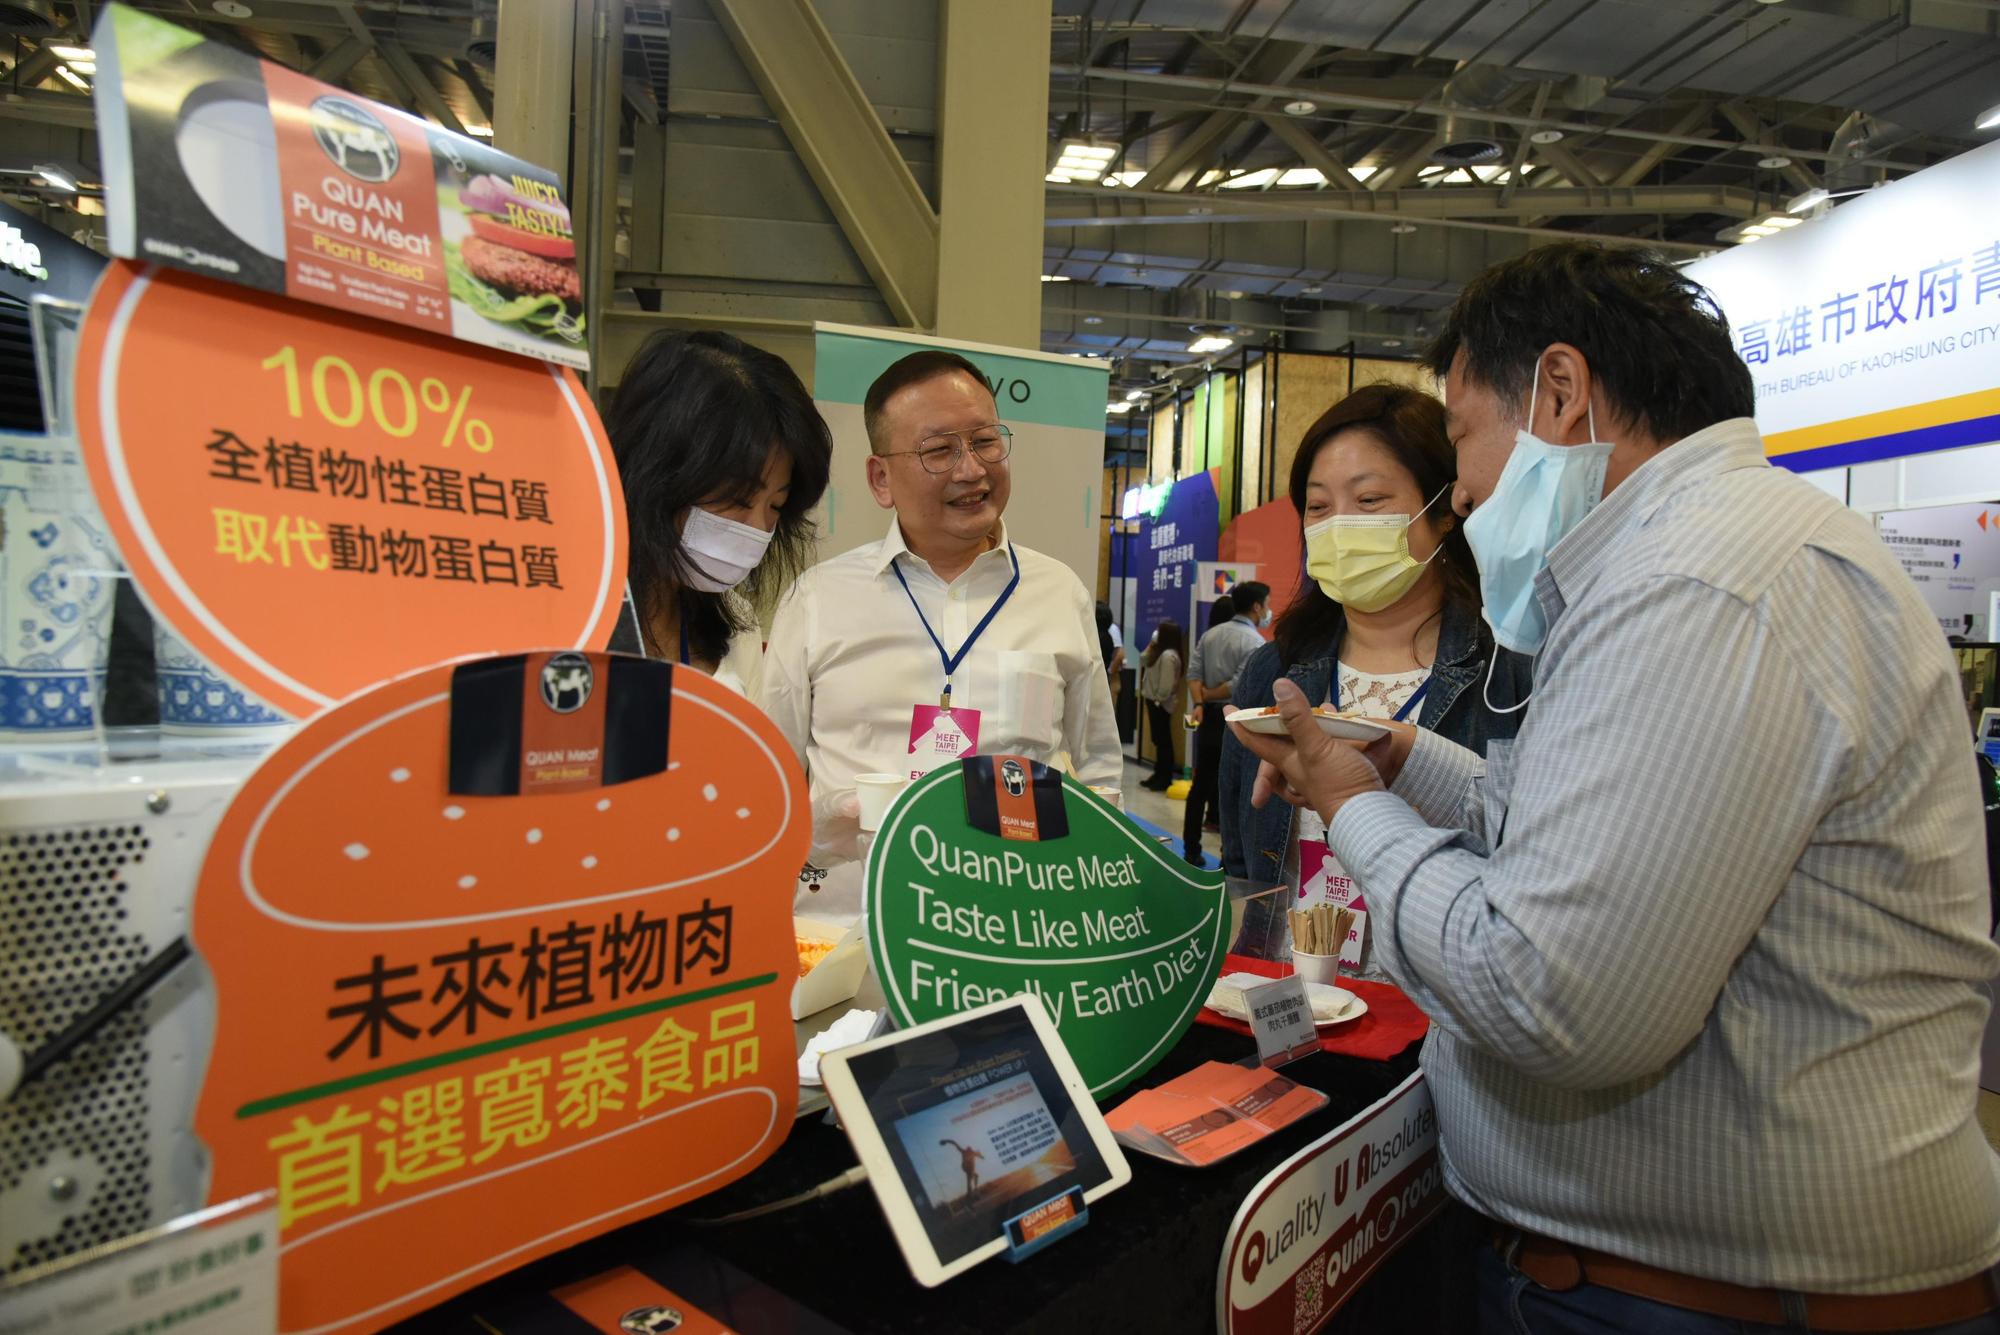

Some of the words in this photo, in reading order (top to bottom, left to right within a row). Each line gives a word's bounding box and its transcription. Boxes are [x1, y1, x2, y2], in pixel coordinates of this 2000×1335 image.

[322, 176, 403, 222] QUAN
[511, 174, 559, 206] JUICY!
[292, 191, 356, 234] Pure
[362, 217, 432, 257] Meat
[504, 202, 566, 240] TASTY!
[312, 234, 362, 263] Plant
[367, 250, 424, 282] Based
[1781, 366, 1835, 394] BUREAU
[1839, 360, 1858, 378] OF
[1862, 336, 1956, 371] KAOHSIUNG
[1960, 324, 2000, 348] CITY
[262, 345, 494, 454] 100%
[204, 428, 553, 525] 全植物性蛋白質
[212, 507, 564, 591] 取代動物蛋白質
[526, 750, 564, 766] QUAN
[568, 747, 599, 762] Meat
[935, 732, 961, 743] MEET
[935, 741, 959, 750] TAIPEI
[1001, 815, 1020, 826] QUAN
[1021, 818, 1035, 829] Meat
[910, 823, 1075, 890] QuanPure
[1077, 853, 1141, 889] Meat
[1326, 875, 1352, 888] MEET
[908, 881, 1005, 945] Taste
[1012, 905, 1078, 948] Like
[1082, 905, 1150, 947] Meat
[1325, 886, 1349, 897] TAIPEI
[326, 899, 734, 1062] 未來植物肉
[1071, 972, 1152, 1018] Earth
[1154, 937, 1206, 994] Diet
[268, 999, 762, 1230] 首選寬泰食品
[1022, 1206, 1048, 1226] QUAN
[1047, 1195, 1070, 1214] Meat
[1242, 1192, 1326, 1286] Quality
[1334, 1158, 1349, 1207] U
